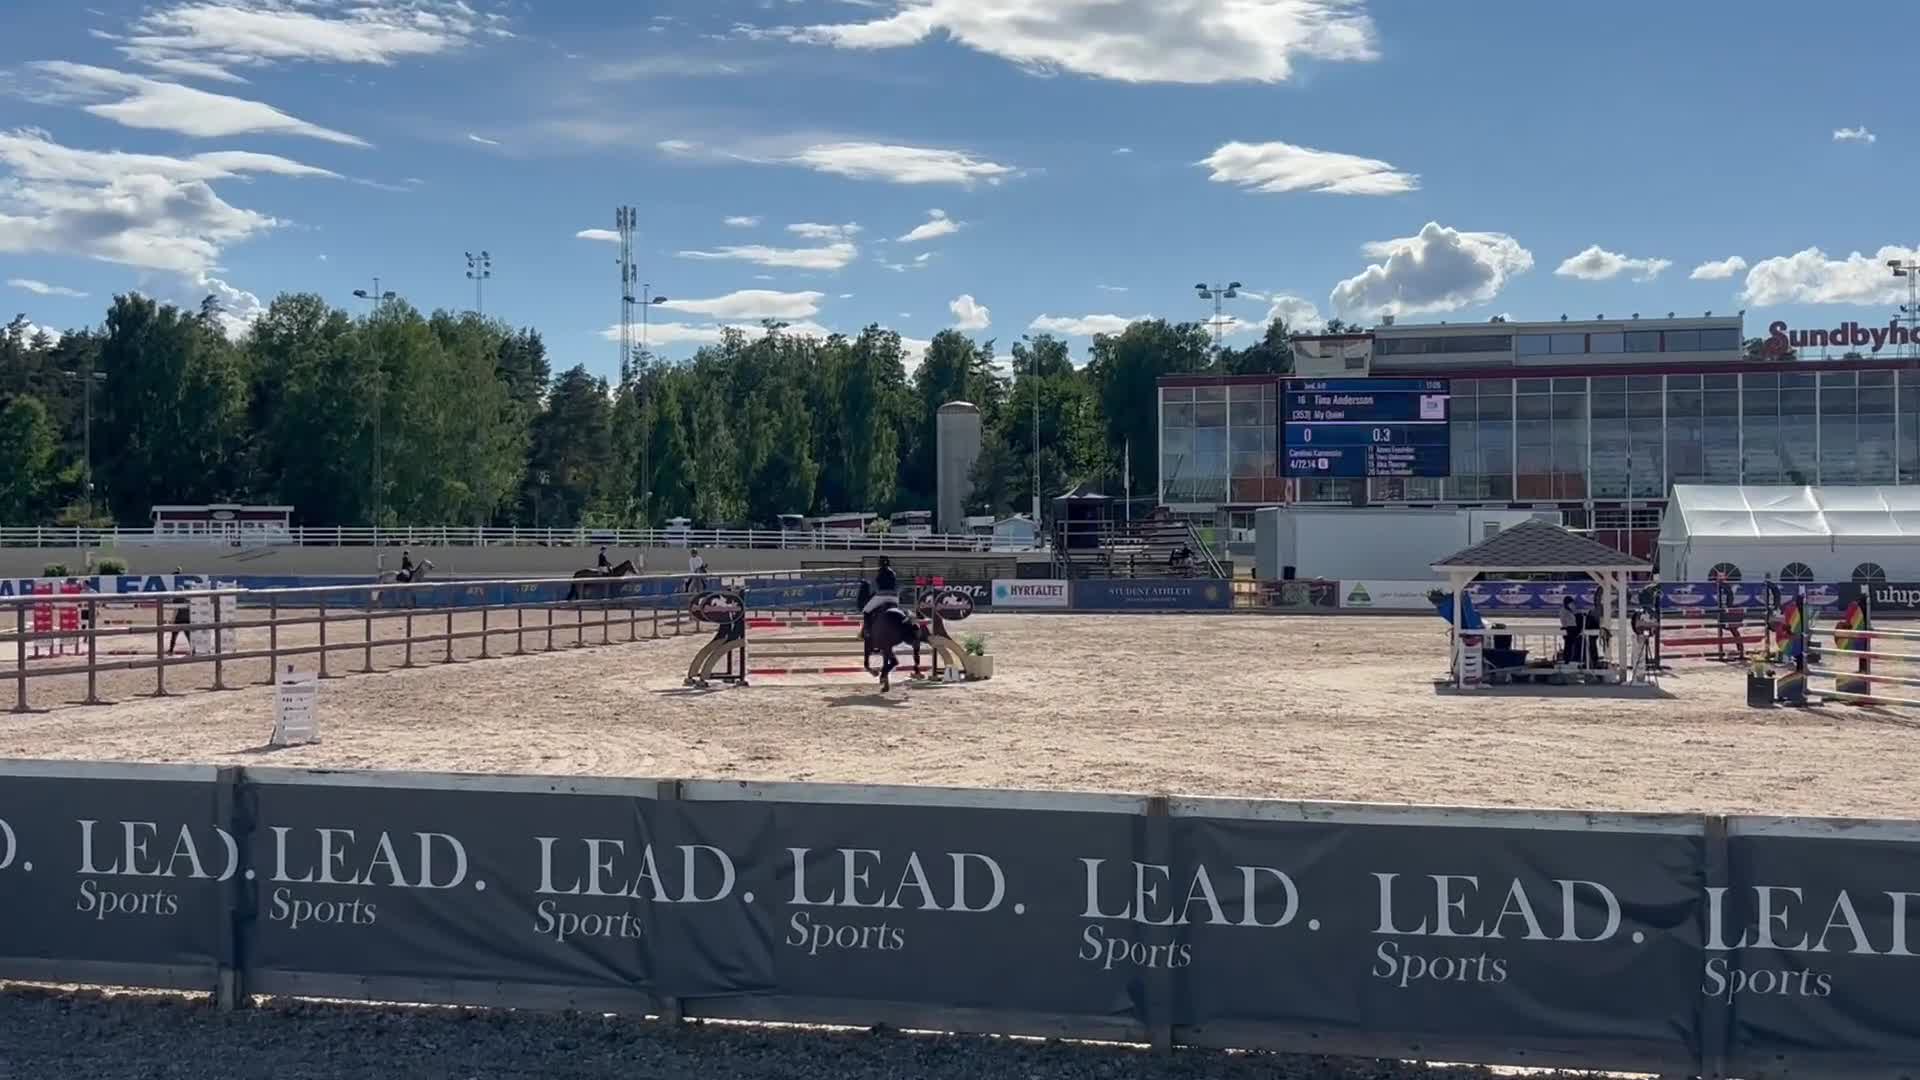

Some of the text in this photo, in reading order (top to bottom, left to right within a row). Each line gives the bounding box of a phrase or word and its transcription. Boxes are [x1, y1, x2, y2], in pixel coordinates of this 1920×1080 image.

[1333, 394, 1374, 405] Andersson
[1304, 428, 1391, 442] 0 0.3
[1010, 584, 1064, 596] HYRTALTET
[1109, 587, 1192, 596] STUDENT ATHLETE
[269, 826, 486, 891] LEAD.
[535, 836, 755, 904] LEAD.
[785, 847, 1025, 915] LEAD.
[76, 879, 178, 920] Sports
[269, 887, 377, 930] Sports
[1079, 857, 1321, 931] LEAD.
[1371, 872, 1645, 944] LEAD.
[533, 900, 642, 943] Sports
[785, 911, 905, 956] Sports
[1078, 924, 1192, 970] Sports
[1371, 940, 1508, 988] Sports
[1702, 957, 1832, 1004] Sports
